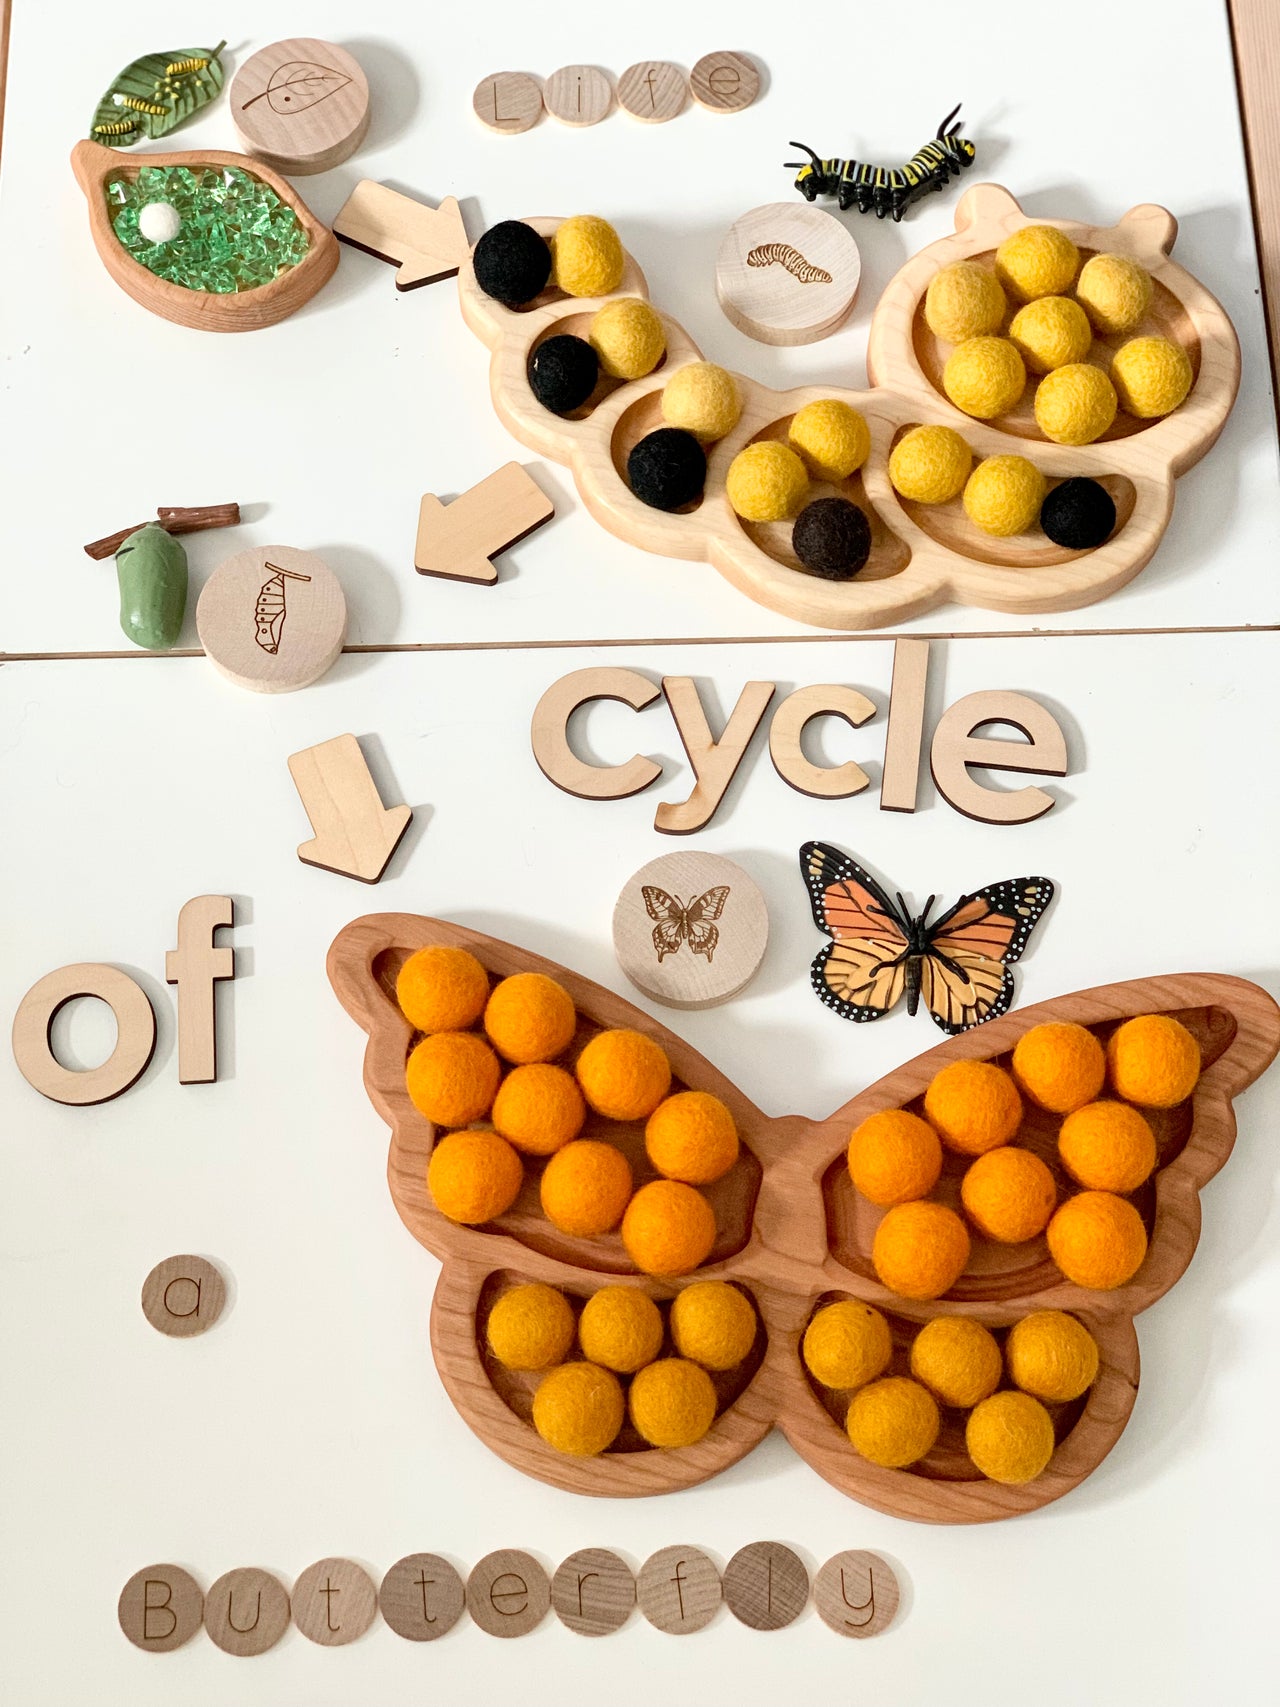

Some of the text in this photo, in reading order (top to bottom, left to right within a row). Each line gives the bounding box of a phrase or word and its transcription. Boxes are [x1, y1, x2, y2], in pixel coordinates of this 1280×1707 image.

[493, 66, 741, 121] Life
[531, 638, 1068, 836] cycle
[12, 894, 235, 1107] of
[163, 1277, 202, 1317] a
[143, 1556, 875, 1640] Butterfly
